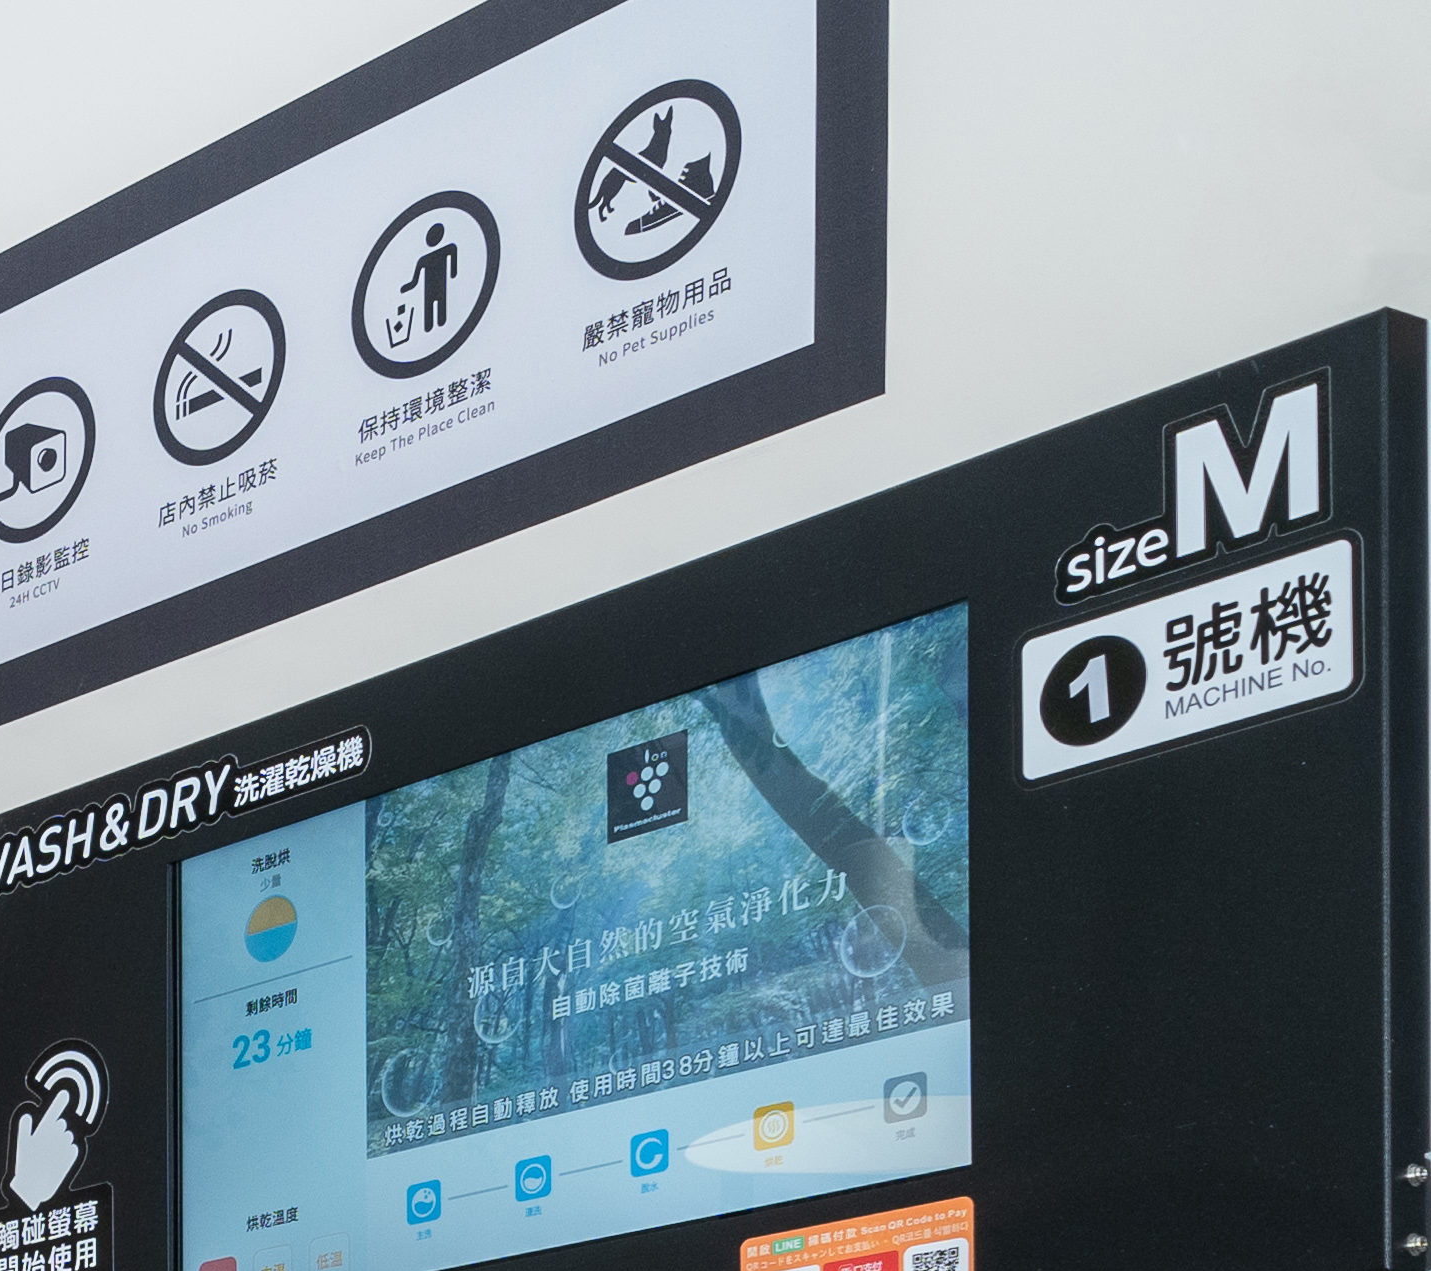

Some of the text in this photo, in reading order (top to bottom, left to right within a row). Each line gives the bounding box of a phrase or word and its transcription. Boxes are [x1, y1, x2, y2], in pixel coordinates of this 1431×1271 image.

[582, 267, 732, 352] 嚴禁寵物用品
[598, 309, 715, 367] No Pet Supplies
[354, 399, 496, 467] Keep The Place Clean
[357, 368, 493, 444] 保持環境整潔
[157, 458, 279, 528] 店內禁止吸菸
[182, 500, 254, 538] No Smoking
[1066, 383, 1320, 593] size M
[9, 578, 61, 609] 24H CCTV
[1069, 572, 1333, 724] 1 號機
[1164, 658, 1331, 720] MACHINE No.
[251, 847, 291, 875] 洗脫烘
[467, 867, 848, 999] 源自大自然的空氣淨化力
[551, 946, 750, 1020] 自動除菌離子技術
[232, 1029, 313, 1070] 23 分鐘
[246, 1206, 300, 1233] 烘乾溫度
[775, 1208, 968, 1252] LINE Scan QR Code to Pay
